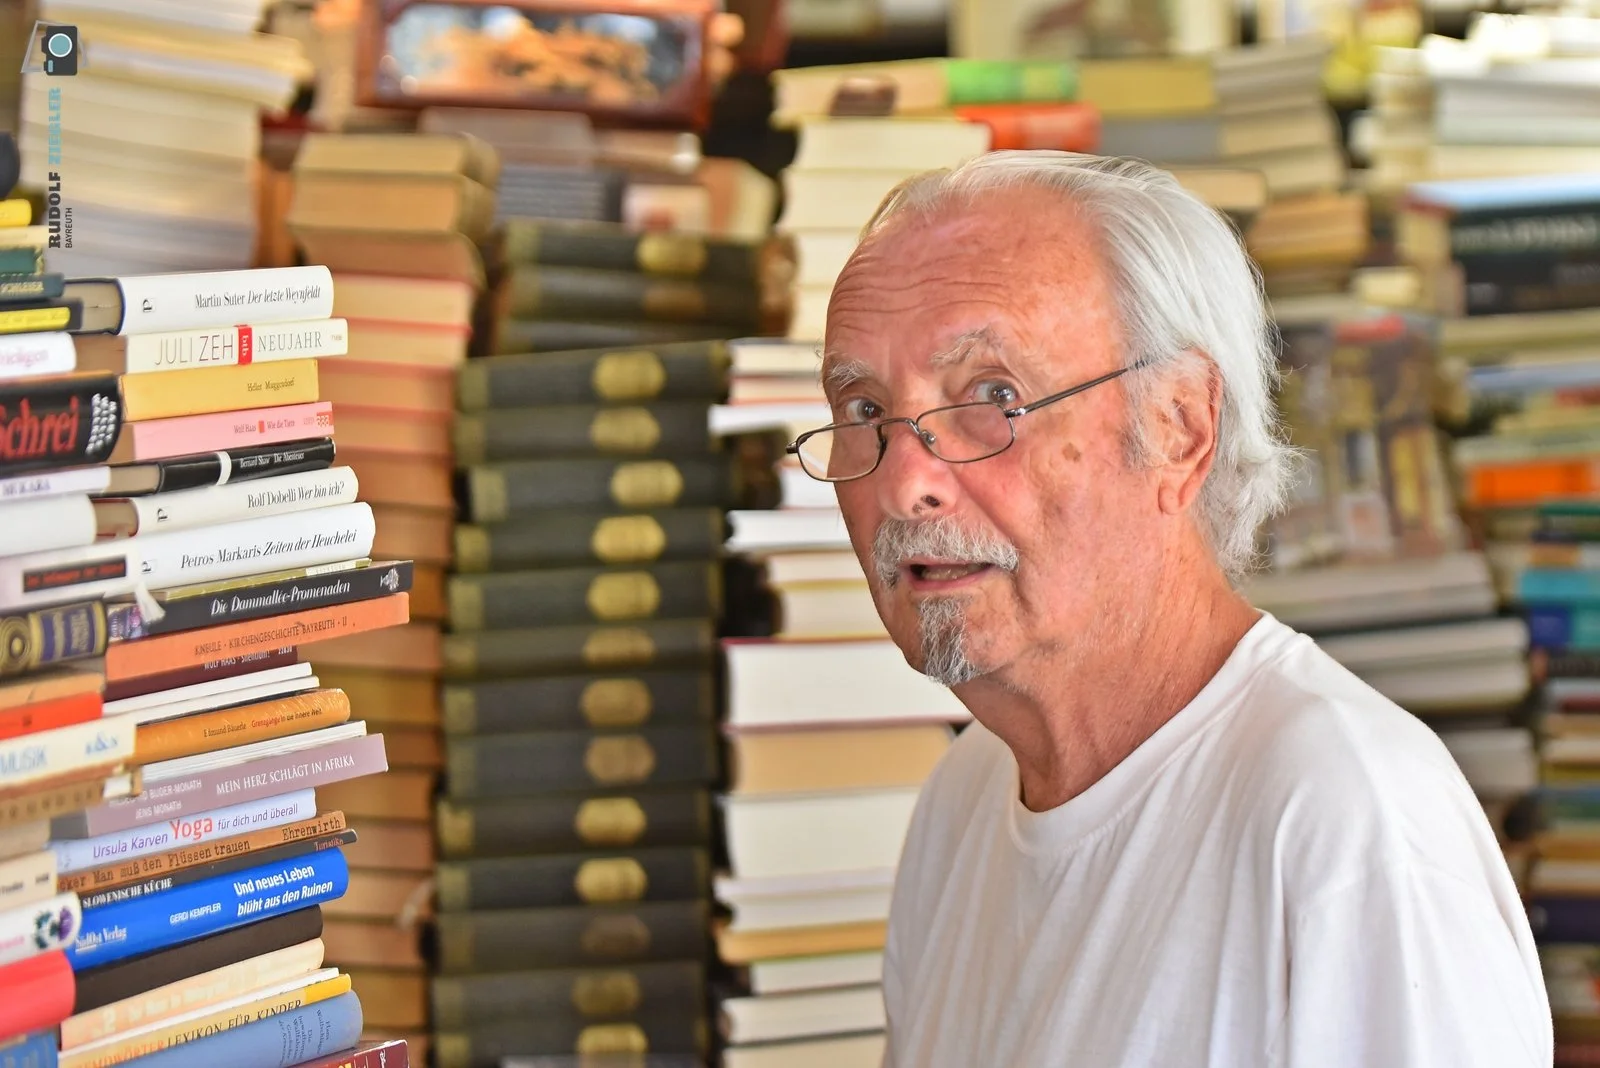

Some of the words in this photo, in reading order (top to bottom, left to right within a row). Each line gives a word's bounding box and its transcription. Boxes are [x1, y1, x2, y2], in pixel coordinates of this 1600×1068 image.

[195, 293, 221, 309] Martin
[223, 291, 245, 307] Suter
[247, 290, 262, 305] Der
[263, 289, 284, 302] letzte
[285, 285, 321, 304] Weynfeldt
[155, 337, 193, 365] JULI
[199, 333, 233, 361] ZEH
[241, 335, 249, 357] btb
[258, 331, 322, 352] NEUJAHR
[248, 493, 265, 509] Rolf
[267, 488, 297, 505] Dobelli
[298, 487, 313, 501] Wer
[313, 484, 327, 498] bin
[328, 481, 345, 496] ich?
[180, 553, 214, 569] Petros
[216, 545, 261, 564] Markaris
[263, 541, 293, 557] Zeiten
[294, 537, 311, 551] der
[311, 529, 357, 547] Heuchelei
[210, 600, 227, 615] Die
[229, 625, 300, 649] KIRCHENGESCHICHTE
[302, 617, 336, 634] BAYREUTH
[216, 778, 241, 795] MEIN
[244, 774, 267, 788] HERZ
[269, 763, 309, 783] SCHLÄGT
[312, 761, 322, 774] IN
[324, 753, 355, 772] AFRIKA
[93, 839, 127, 859] Ursula
[131, 833, 168, 851] Karven
[169, 816, 213, 842] Yoga
[217, 819, 231, 831] für
[232, 815, 251, 828] dich
[252, 811, 268, 823] und
[270, 804, 298, 820] überall
[92, 869, 113, 882] Man
[120, 863, 140, 878] muß
[142, 857, 162, 872] den
[168, 848, 212, 867] Flüssen
[214, 840, 250, 857] trauen
[282, 816, 341, 841] Ehrenwirth
[82, 884, 142, 908] SLOWENISCHE
[144, 877, 173, 893] KÜCHE
[233, 879, 254, 897] Und
[256, 874, 285, 892] neues
[286, 864, 315, 883] Leben
[169, 910, 188, 924] GERDI
[189, 902, 222, 920] KEMPFLER
[237, 898, 262, 917] blüht
[264, 896, 281, 910] aus
[282, 890, 299, 905] den
[301, 880, 333, 898] Ruinen
[167, 1022, 223, 1049] LEXIKON
[228, 1014, 250, 1030] FÜR
[257, 1000, 301, 1021] KINDER
